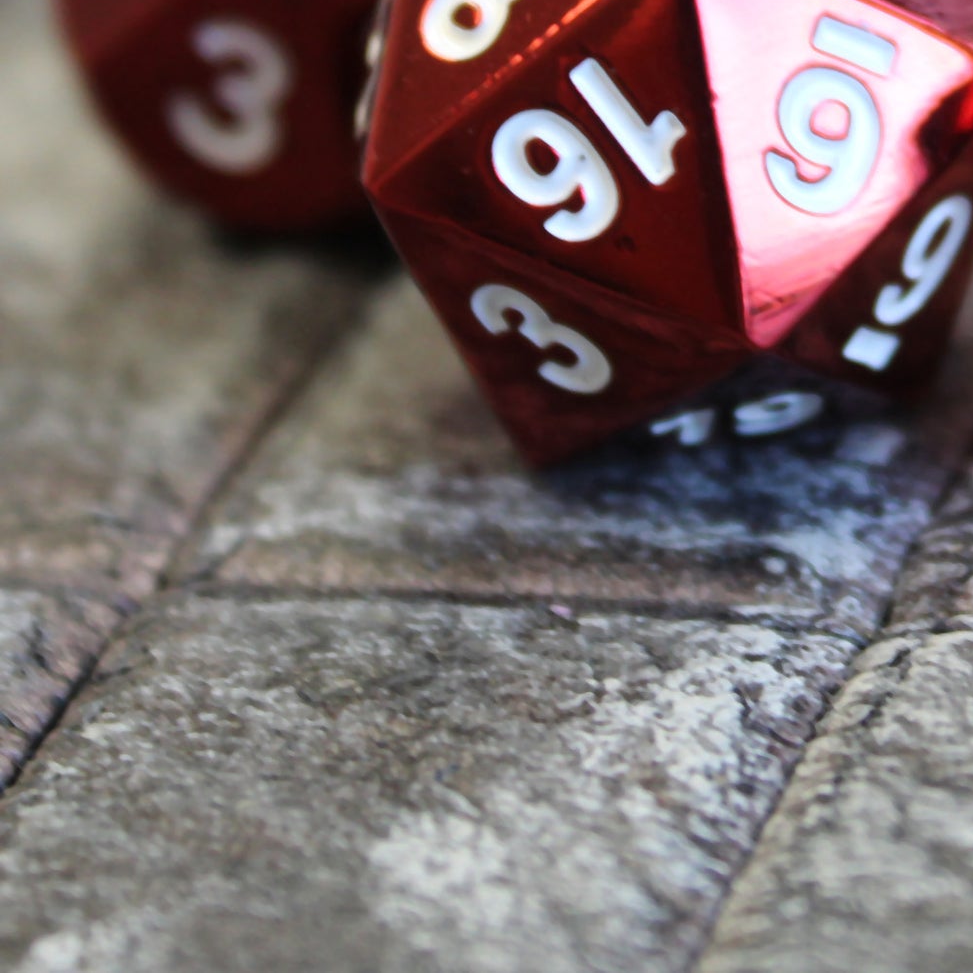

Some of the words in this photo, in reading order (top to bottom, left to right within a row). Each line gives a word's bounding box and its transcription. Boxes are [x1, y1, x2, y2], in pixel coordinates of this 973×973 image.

[170, 22, 291, 174] 3
[491, 57, 687, 242] 16
[470, 283, 612, 394] 3
